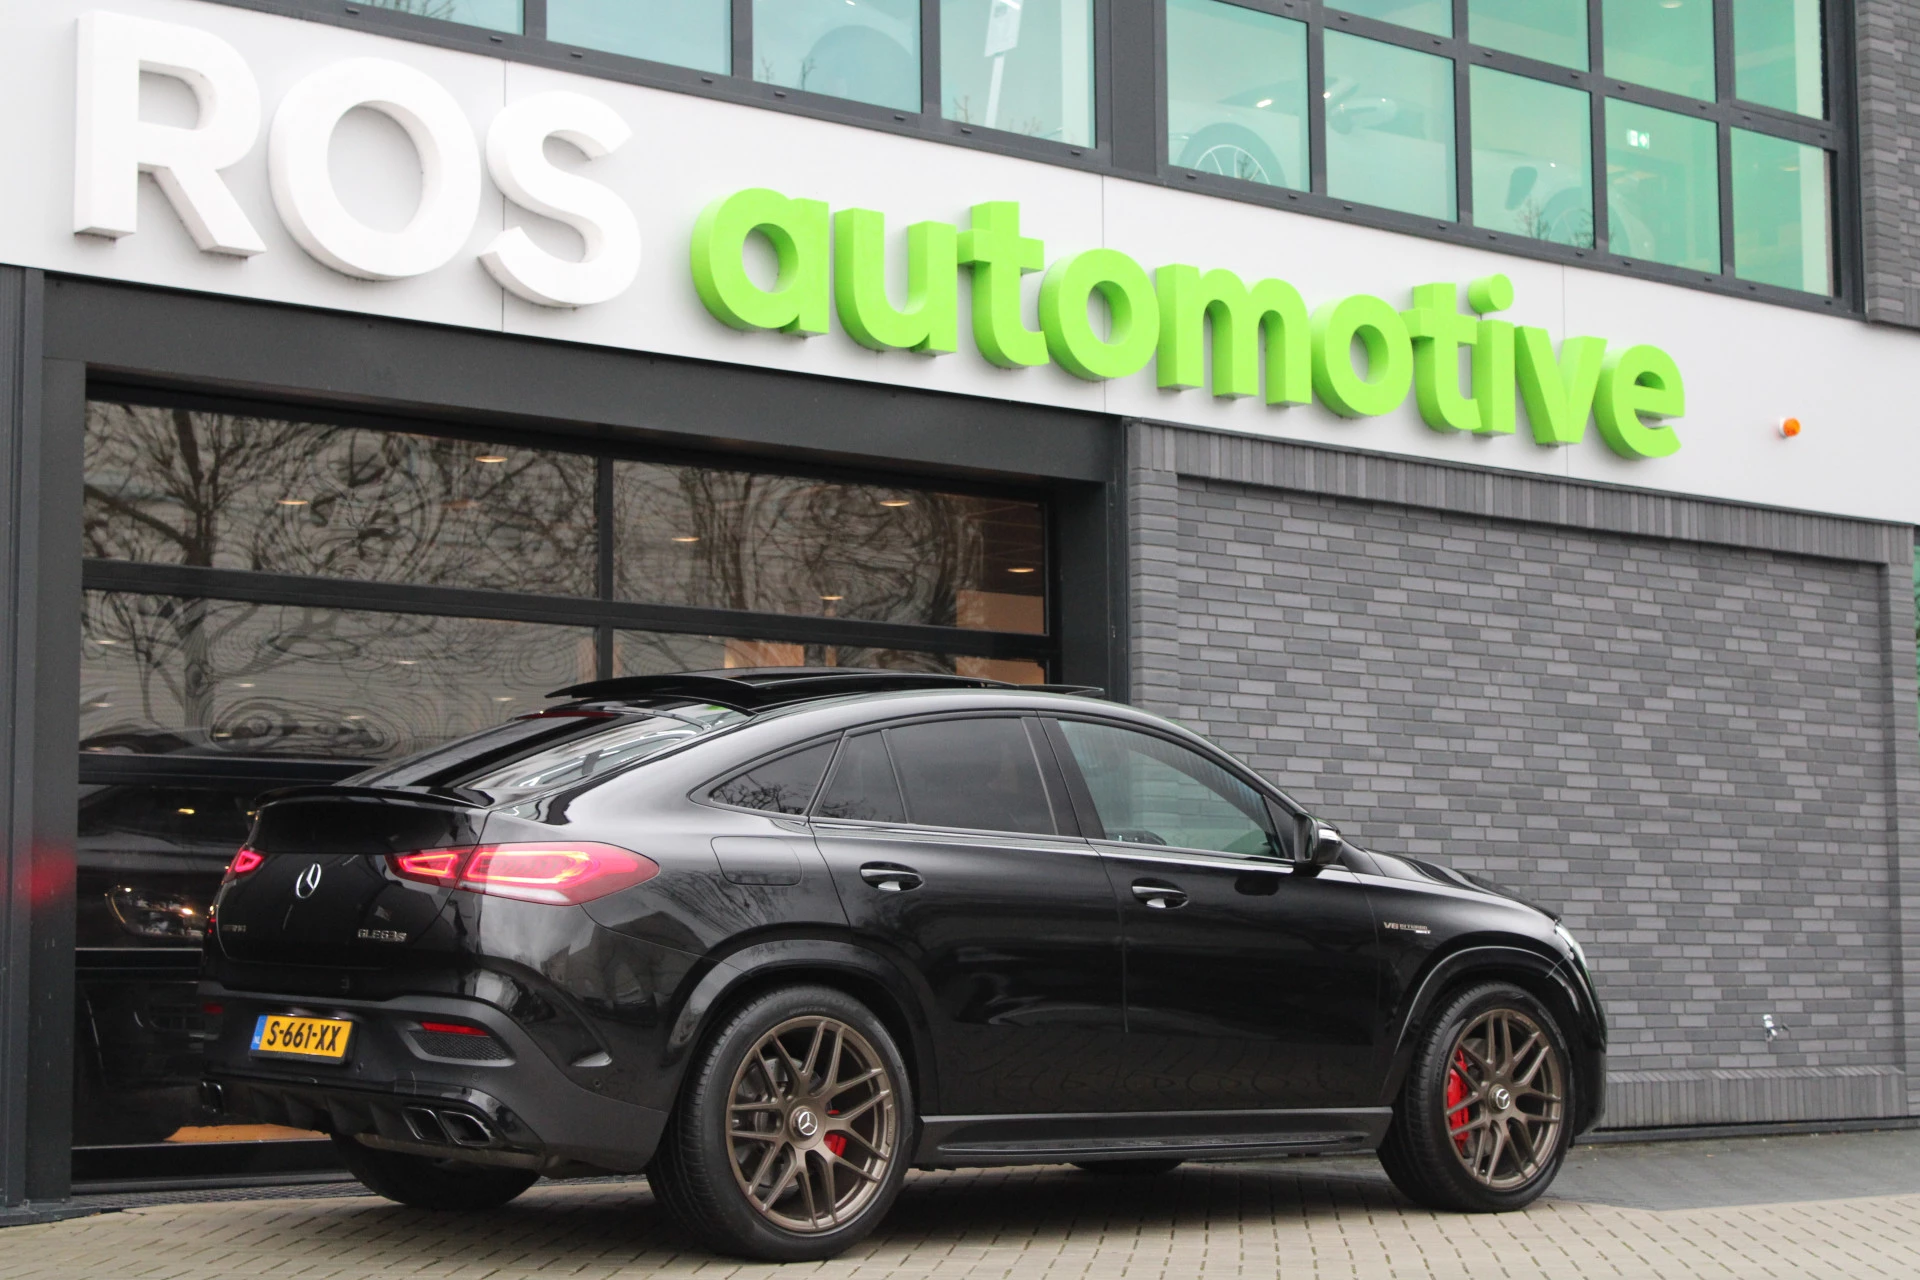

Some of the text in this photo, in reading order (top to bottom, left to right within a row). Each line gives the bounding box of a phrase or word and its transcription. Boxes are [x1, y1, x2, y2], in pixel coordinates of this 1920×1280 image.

[74, 12, 1686, 459] ROS automotive
[267, 1020, 342, 1052] S-661-XX
